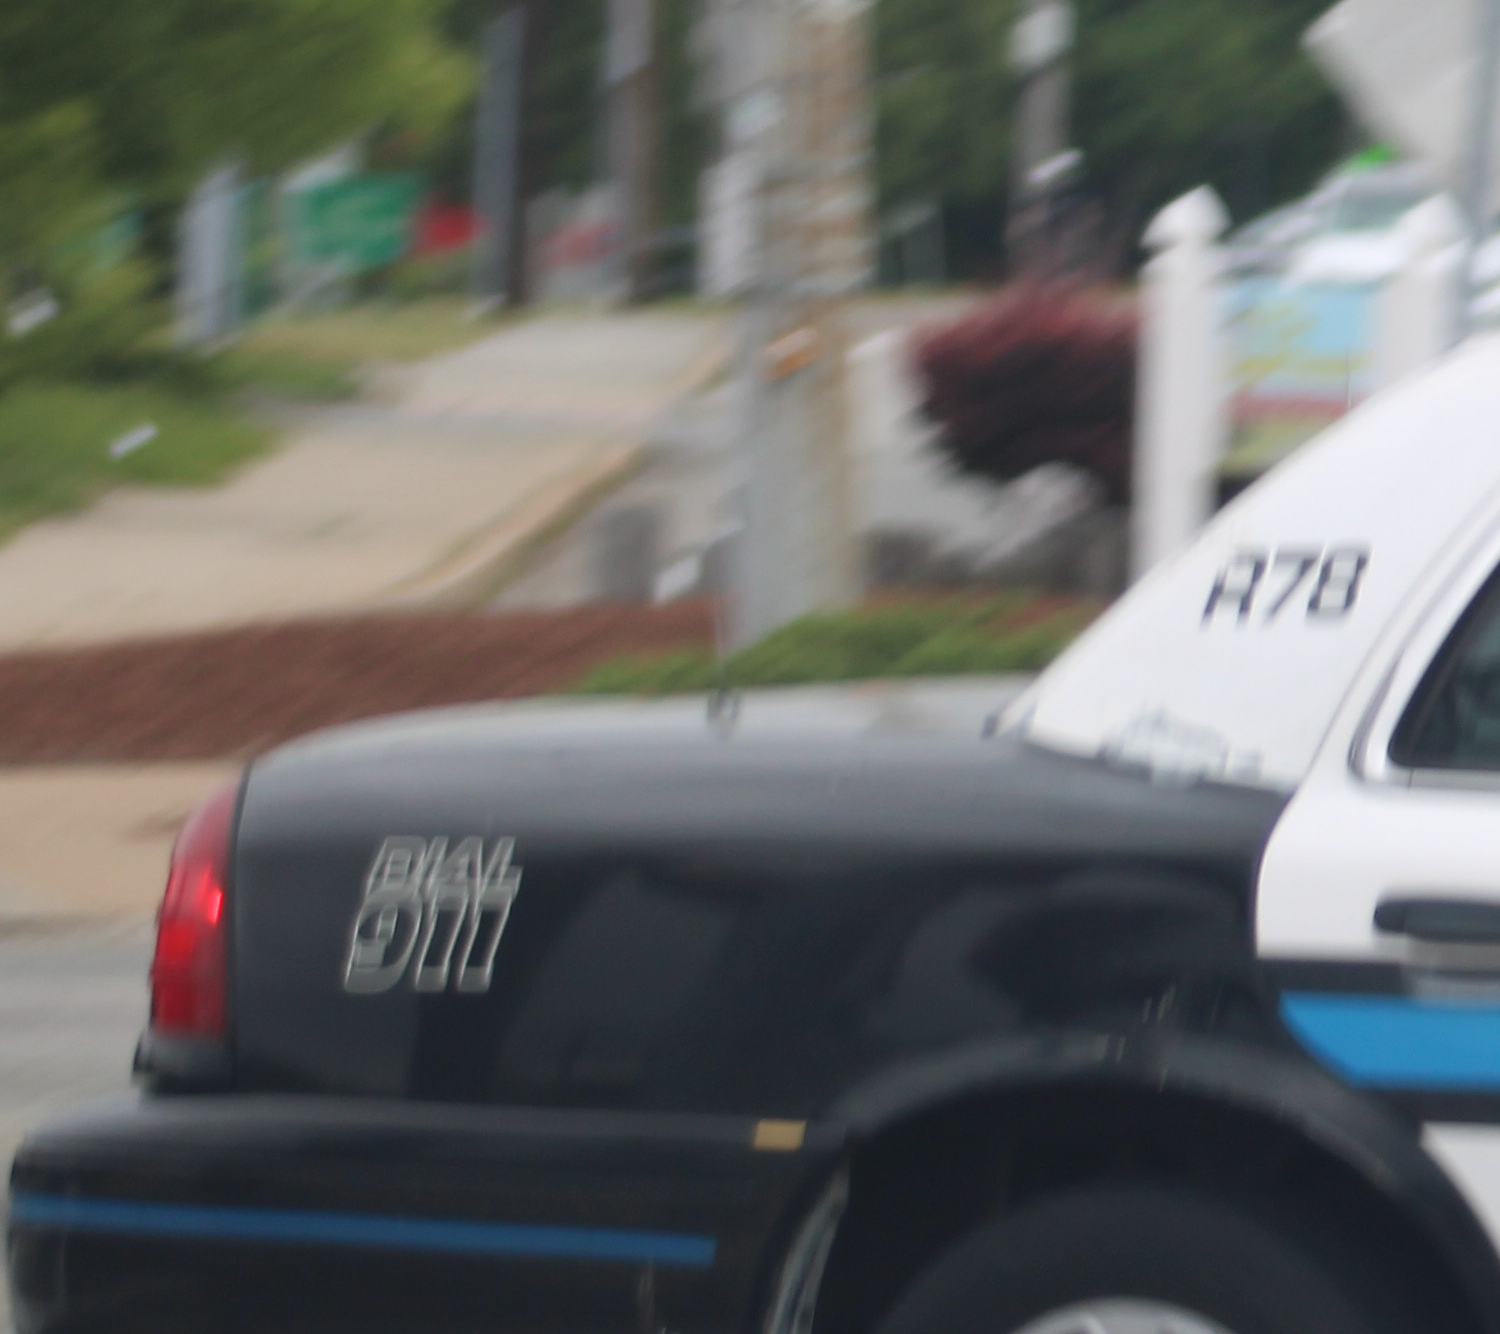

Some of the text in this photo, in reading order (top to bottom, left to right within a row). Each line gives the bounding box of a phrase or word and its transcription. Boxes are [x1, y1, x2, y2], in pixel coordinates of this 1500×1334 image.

[1200, 545, 1371, 629] R78
[362, 834, 516, 901] DIAL
[344, 866, 523, 994] 911
